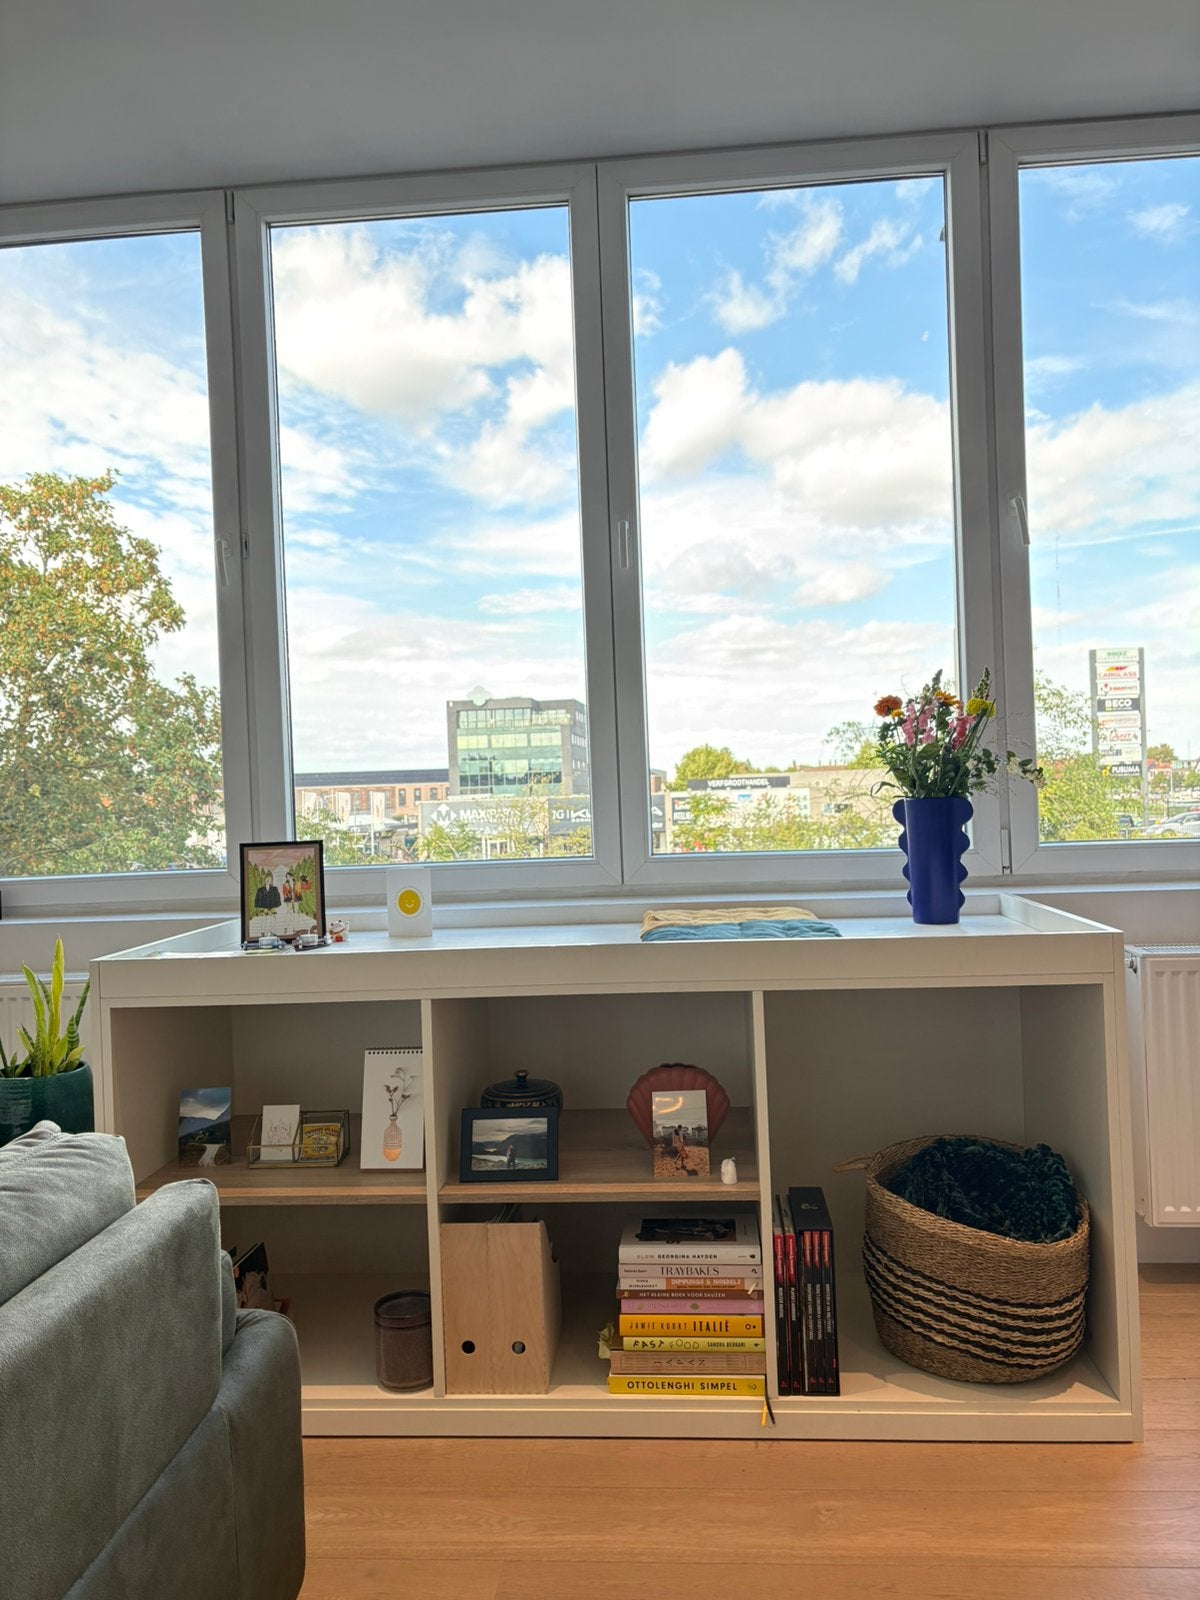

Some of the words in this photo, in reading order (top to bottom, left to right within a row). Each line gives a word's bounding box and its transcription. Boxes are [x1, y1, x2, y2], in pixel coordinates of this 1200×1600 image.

[1105, 699, 1132, 707] BECO
[661, 1266, 720, 1276] TRAYBAKES
[629, 1321, 656, 1330] JAMIE
[632, 1340, 665, 1349] FAST
[668, 1339, 700, 1349] FOOD
[626, 1381, 695, 1390] OTTOLENGHI
[700, 1381, 737, 1391] SIMPEL
